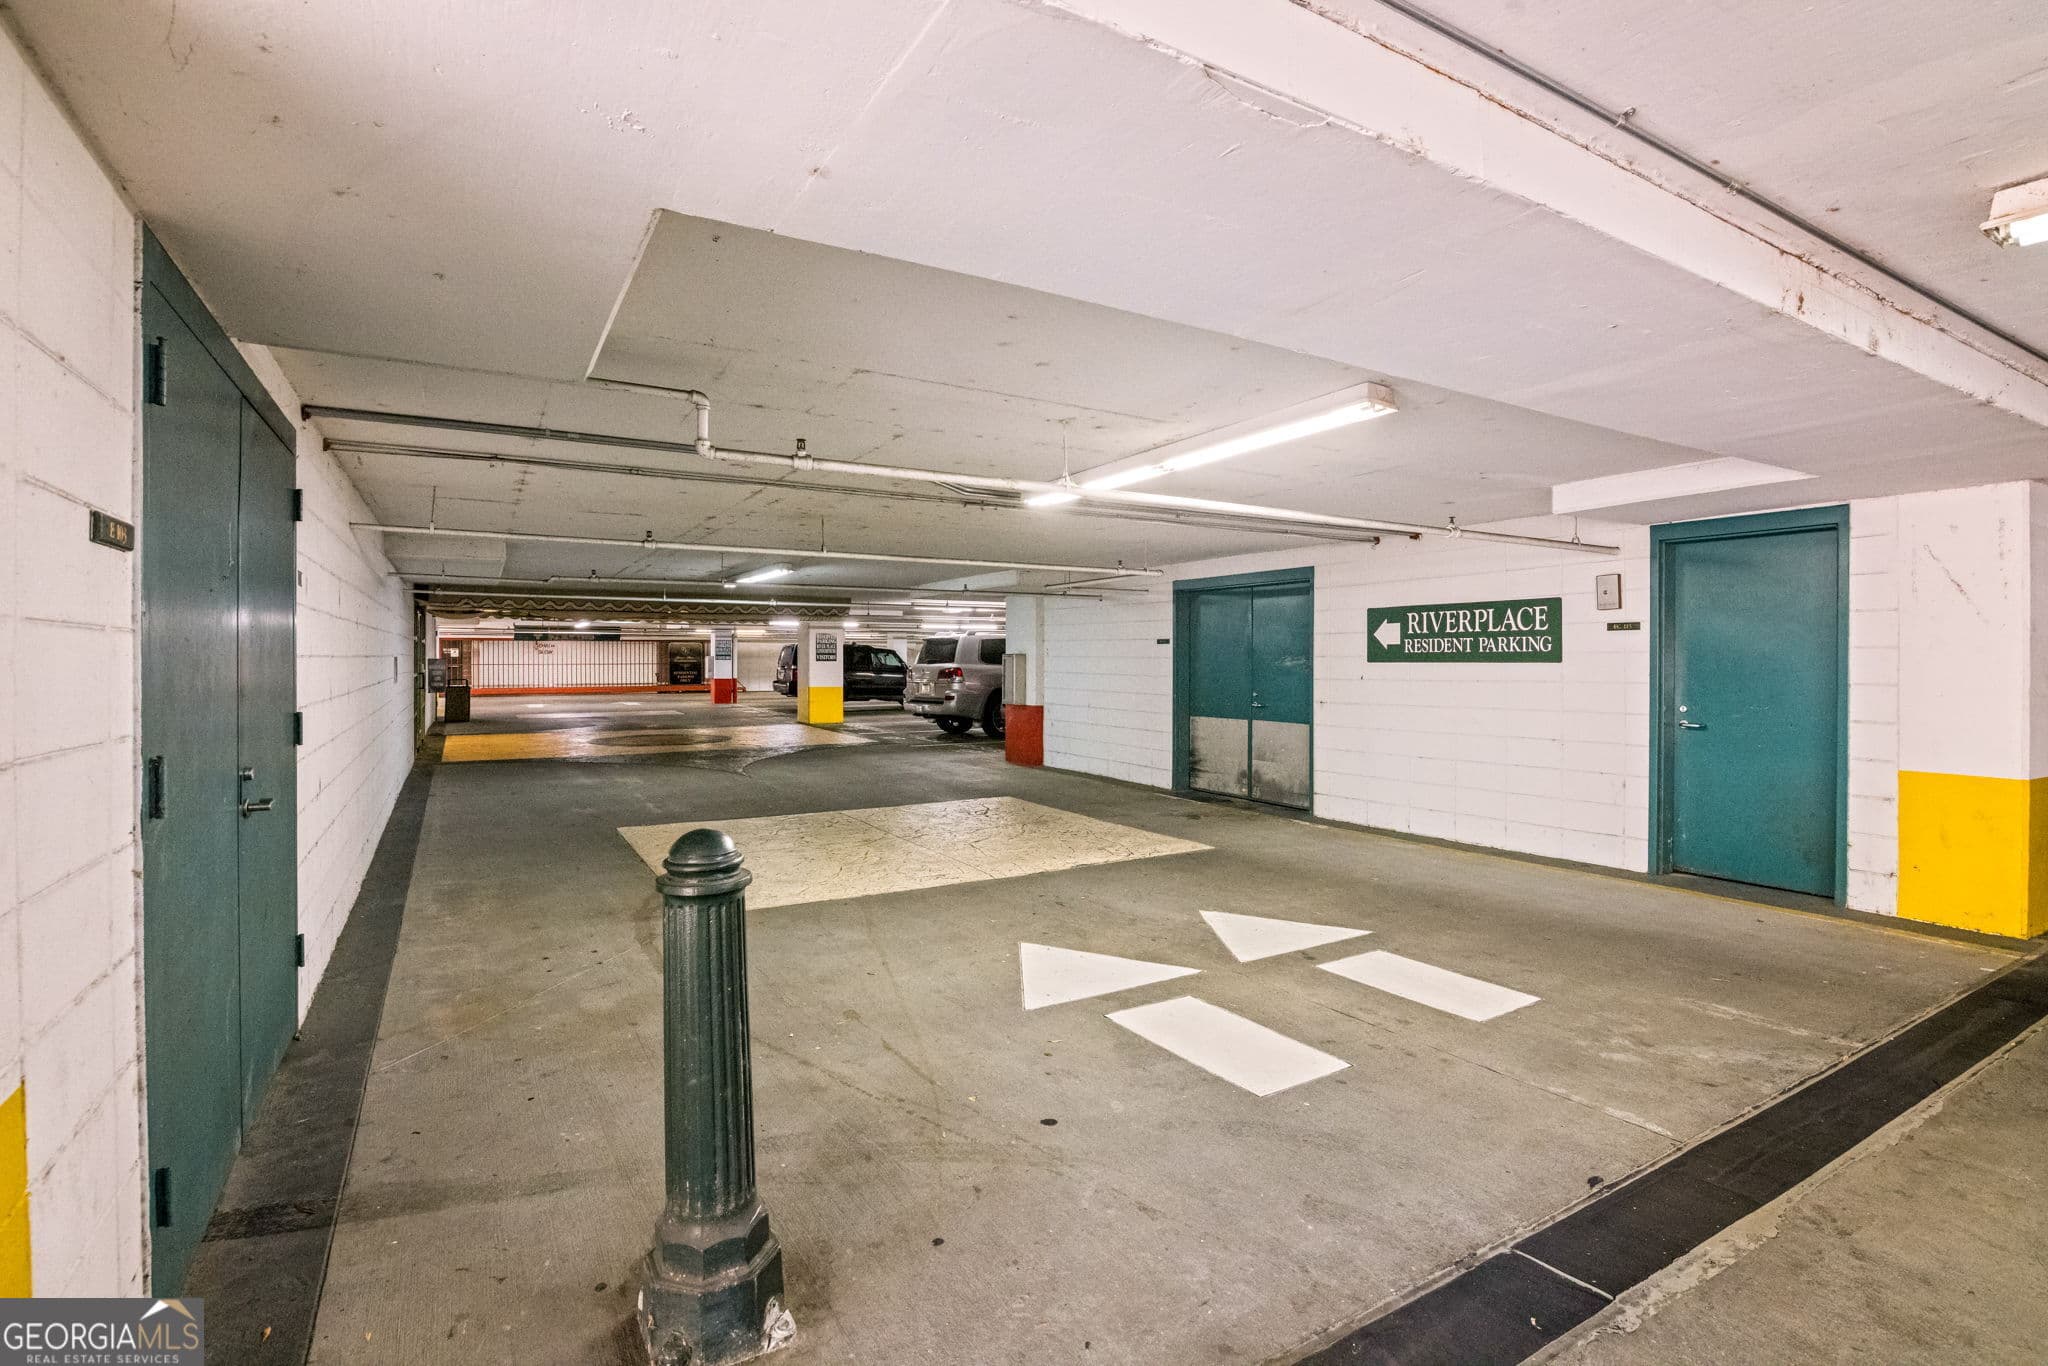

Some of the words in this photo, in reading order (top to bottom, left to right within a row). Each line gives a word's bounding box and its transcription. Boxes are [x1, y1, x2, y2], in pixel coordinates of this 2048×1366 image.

[1407, 606, 1549, 634] RIVERPLACE
[1404, 637, 1473, 653] RESIDENT
[1479, 636, 1552, 652] PARKING
